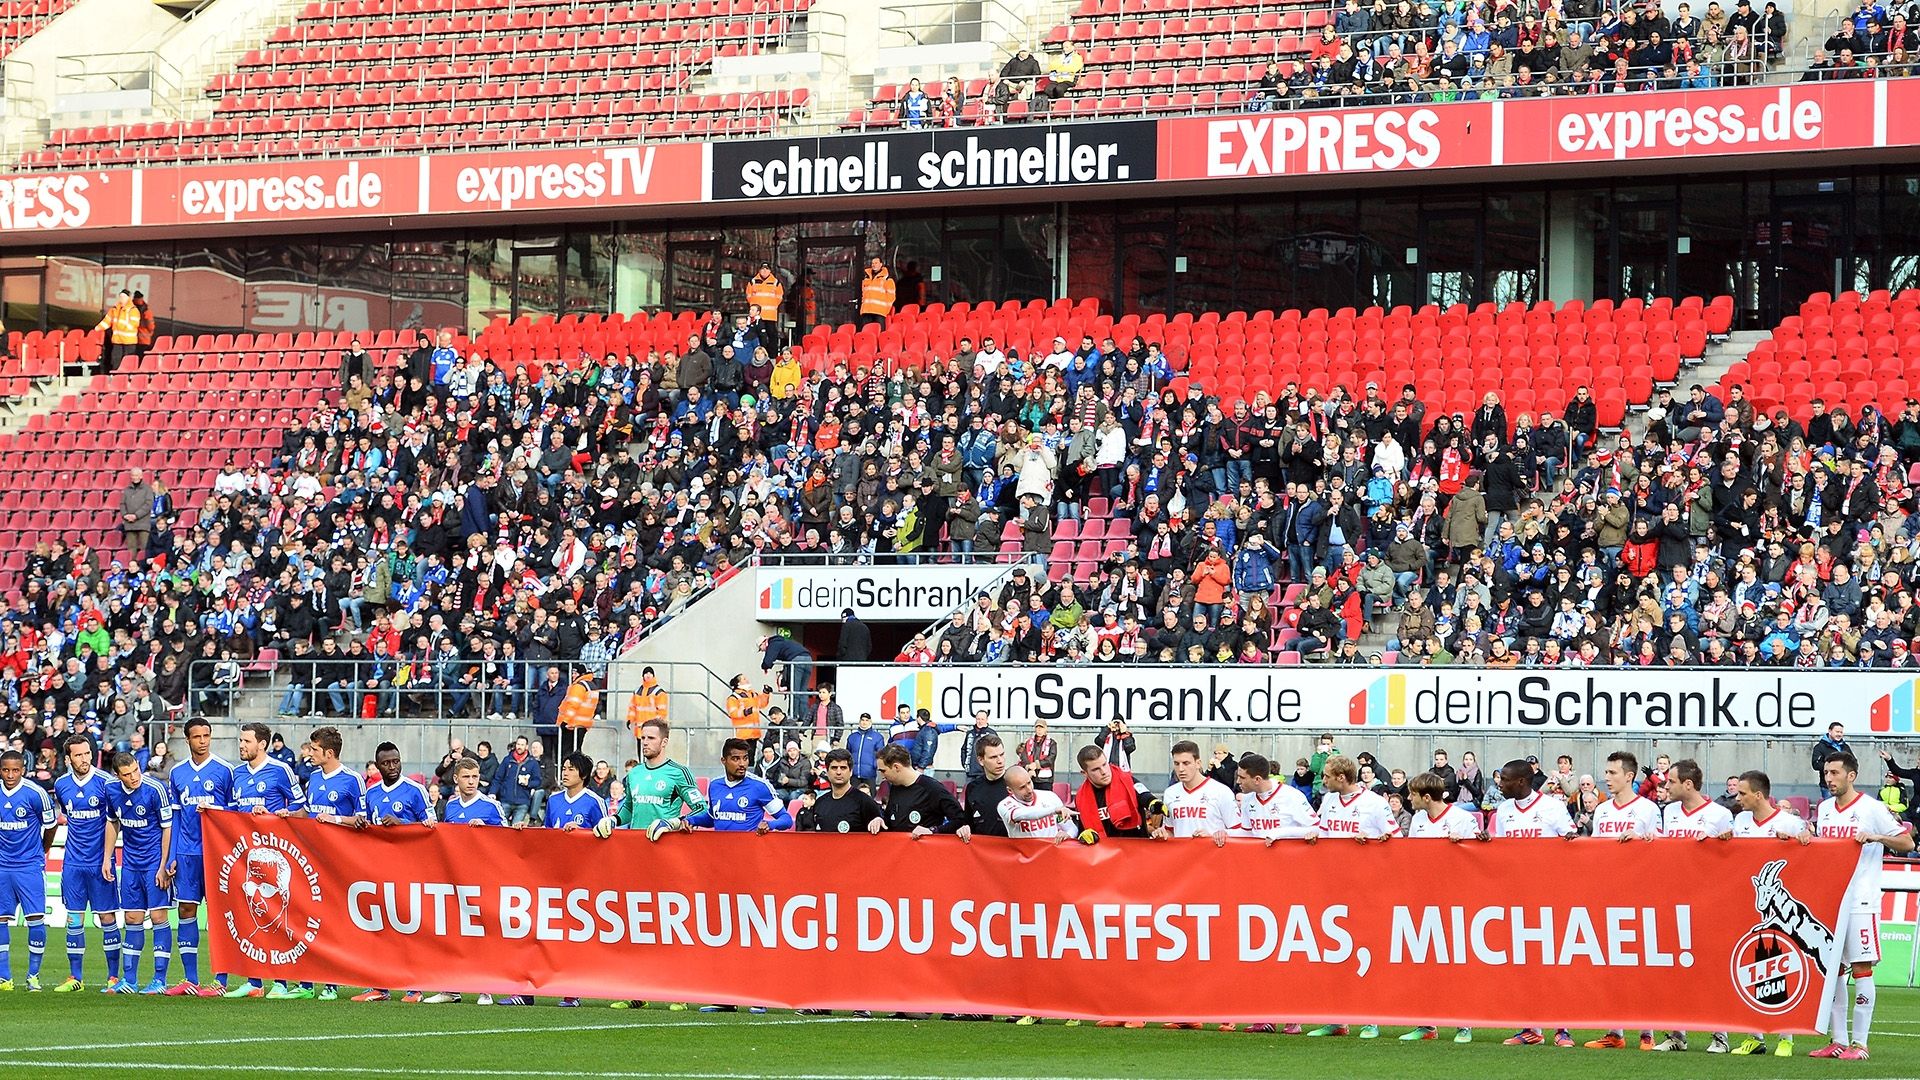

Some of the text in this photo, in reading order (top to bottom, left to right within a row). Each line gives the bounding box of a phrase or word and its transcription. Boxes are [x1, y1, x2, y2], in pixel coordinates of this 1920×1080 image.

[1558, 88, 1822, 160] express.de
[1207, 109, 1441, 177] EXPRESS
[456, 147, 656, 210] expressTV
[741, 132, 1129, 197] schnell. schneller.
[182, 161, 382, 222] express.de
[798, 578, 1003, 609] deinSchrank
[940, 673, 1301, 723] deinSchrank.de
[1415, 675, 1816, 728] deinSchrank.de
[1020, 815, 1056, 833] REWE
[1172, 807, 1206, 820] REWE
[1250, 818, 1281, 830] REWE
[1327, 819, 1359, 833] REWE
[1599, 821, 1634, 833] REWE
[1822, 826, 1858, 838] REWE
[219, 831, 322, 901] Michael Schumacher
[224, 910, 267, 963] Fan-Club
[270, 940, 308, 965] Kerpen
[304, 917, 321, 943] e.V.
[347, 880, 1695, 977] GUTE BESSERUNG! DU SCHAFFST DAS, MICHAEL!
[1860, 929, 1869, 945] 5
[1881, 931, 1912, 941] erima
[1748, 955, 1790, 983] 1.FC
[1755, 979, 1786, 1000] KÖLN
